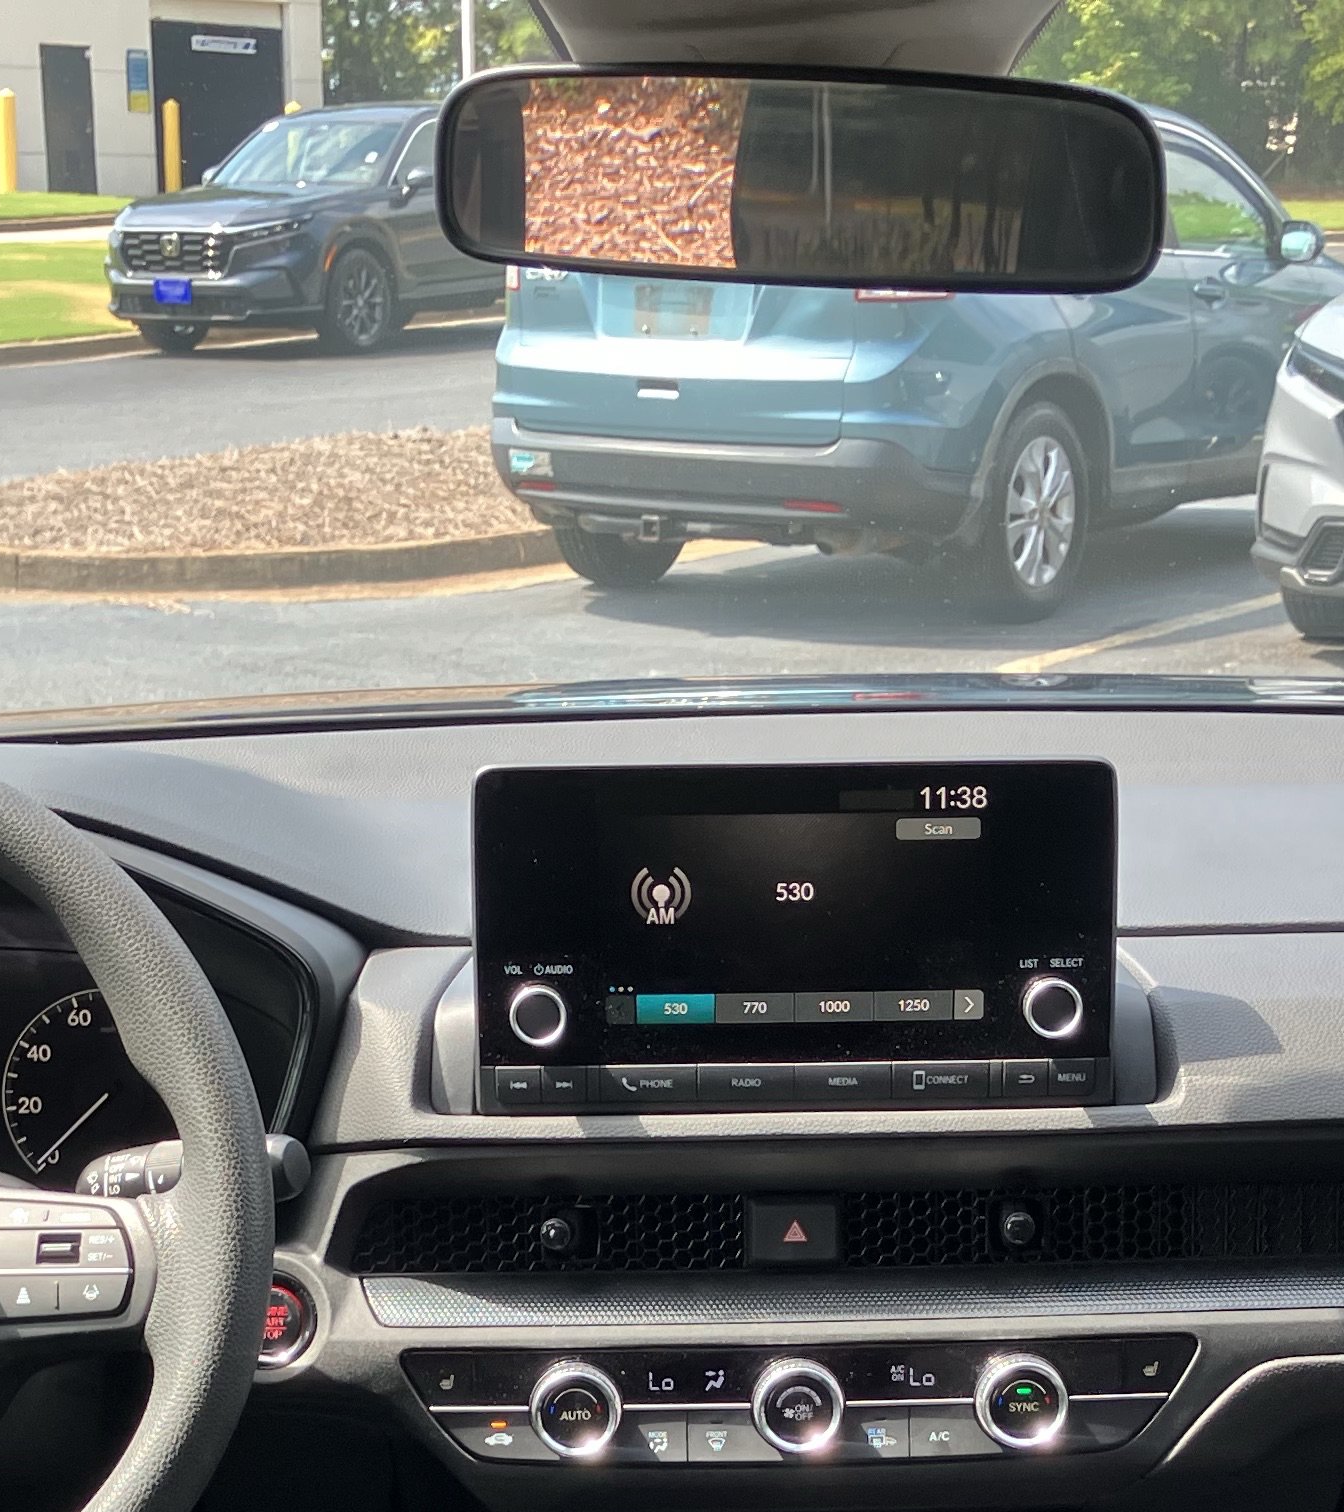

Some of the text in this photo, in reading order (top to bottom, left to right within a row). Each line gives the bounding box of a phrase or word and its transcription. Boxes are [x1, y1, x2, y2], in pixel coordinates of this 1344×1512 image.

[920, 785, 988, 810] 11:38
[924, 823, 953, 836] Scan
[776, 882, 815, 902] 530
[646, 907, 675, 925] AM
[1019, 958, 1039, 969] LIST
[1050, 957, 1084, 968] SELECT
[504, 965, 523, 975] VOL
[545, 964, 574, 975] AUDIO
[663, 1002, 689, 1015] 530
[743, 1001, 768, 1014] 770
[819, 1000, 851, 1013] 1000
[898, 999, 931, 1012] 1250
[67, 1008, 92, 1027] 60
[26, 1044, 52, 1062] 40
[731, 1077, 762, 1088] RADIO
[828, 1077, 858, 1087] MEDIA
[926, 1074, 969, 1085] CONNECT
[1057, 1072, 1086, 1082] MENU
[639, 1079, 674, 1089] PHONE
[18, 1096, 43, 1114] 20
[109, 1162, 126, 1173] OFF
[109, 1172, 123, 1183] INT
[108, 1184, 121, 1195] LO
[890, 1365, 905, 1374] A/C
[648, 1371, 674, 1391] Lo
[891, 1373, 905, 1382] ON
[909, 1367, 935, 1387] Lo
[794, 1404, 814, 1413] ON/
[1008, 1401, 1040, 1413] SYNC
[560, 1408, 592, 1421] AUTO
[794, 1412, 814, 1421] OFF
[648, 1430, 668, 1438] MODE
[706, 1430, 729, 1438] FRONT
[928, 1431, 950, 1441] A/C
